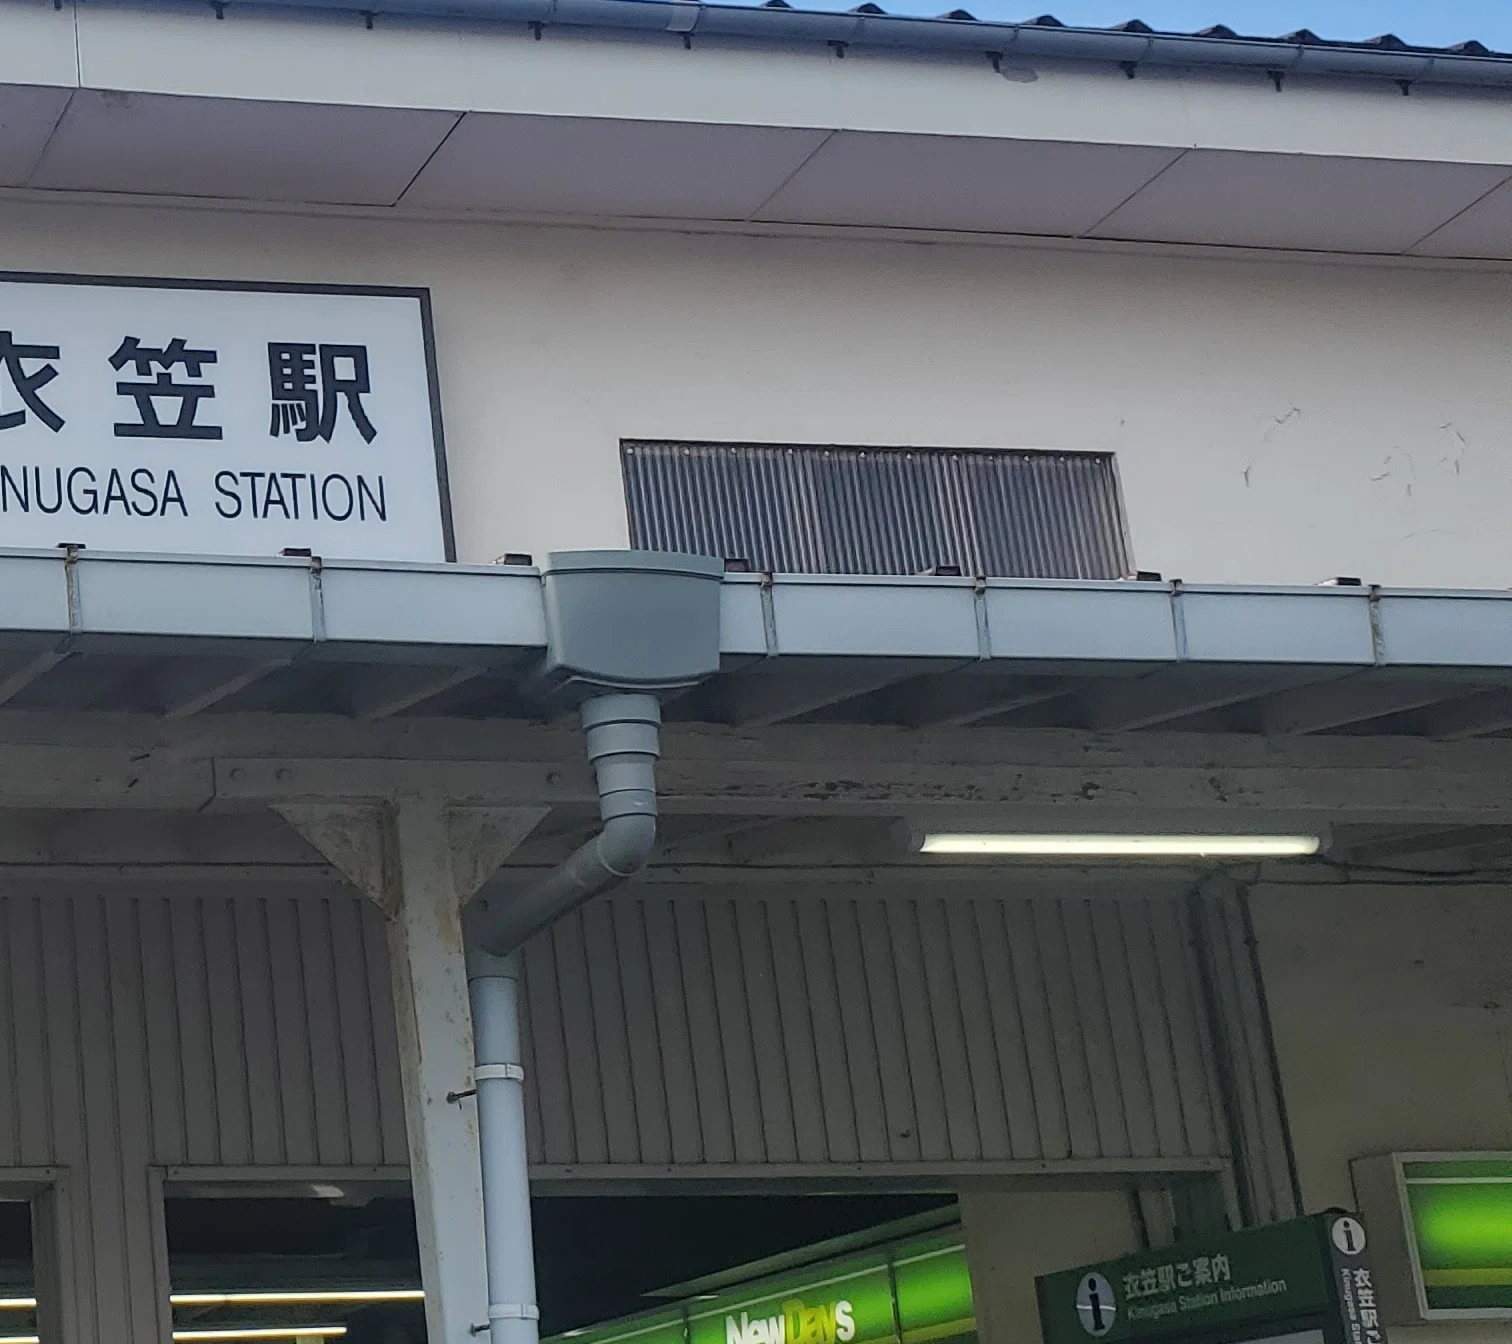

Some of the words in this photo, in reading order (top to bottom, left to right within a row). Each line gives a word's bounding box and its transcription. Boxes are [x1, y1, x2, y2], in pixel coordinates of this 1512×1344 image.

[214, 469, 388, 523] STATION
[1122, 1253, 1232, 1301] 衣笠駅ご案内
[1178, 1290, 1218, 1310] Station
[1219, 1278, 1288, 1303] Information
